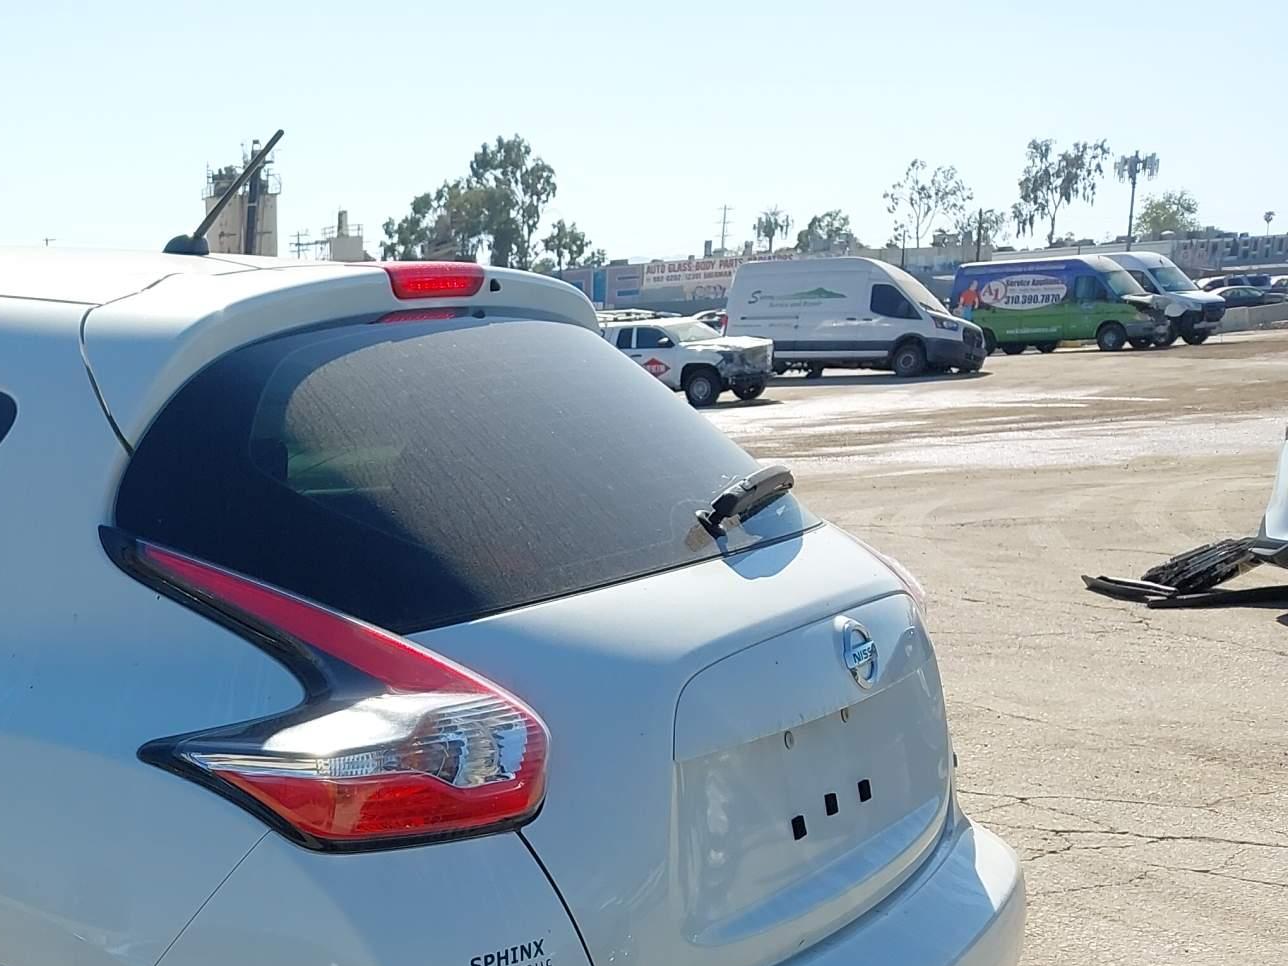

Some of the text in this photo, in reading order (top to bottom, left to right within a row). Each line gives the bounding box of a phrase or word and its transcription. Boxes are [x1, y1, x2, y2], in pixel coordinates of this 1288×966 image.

[646, 264, 665, 275] AUTO
[668, 262, 692, 273] GLASS
[695, 260, 715, 272] BODY
